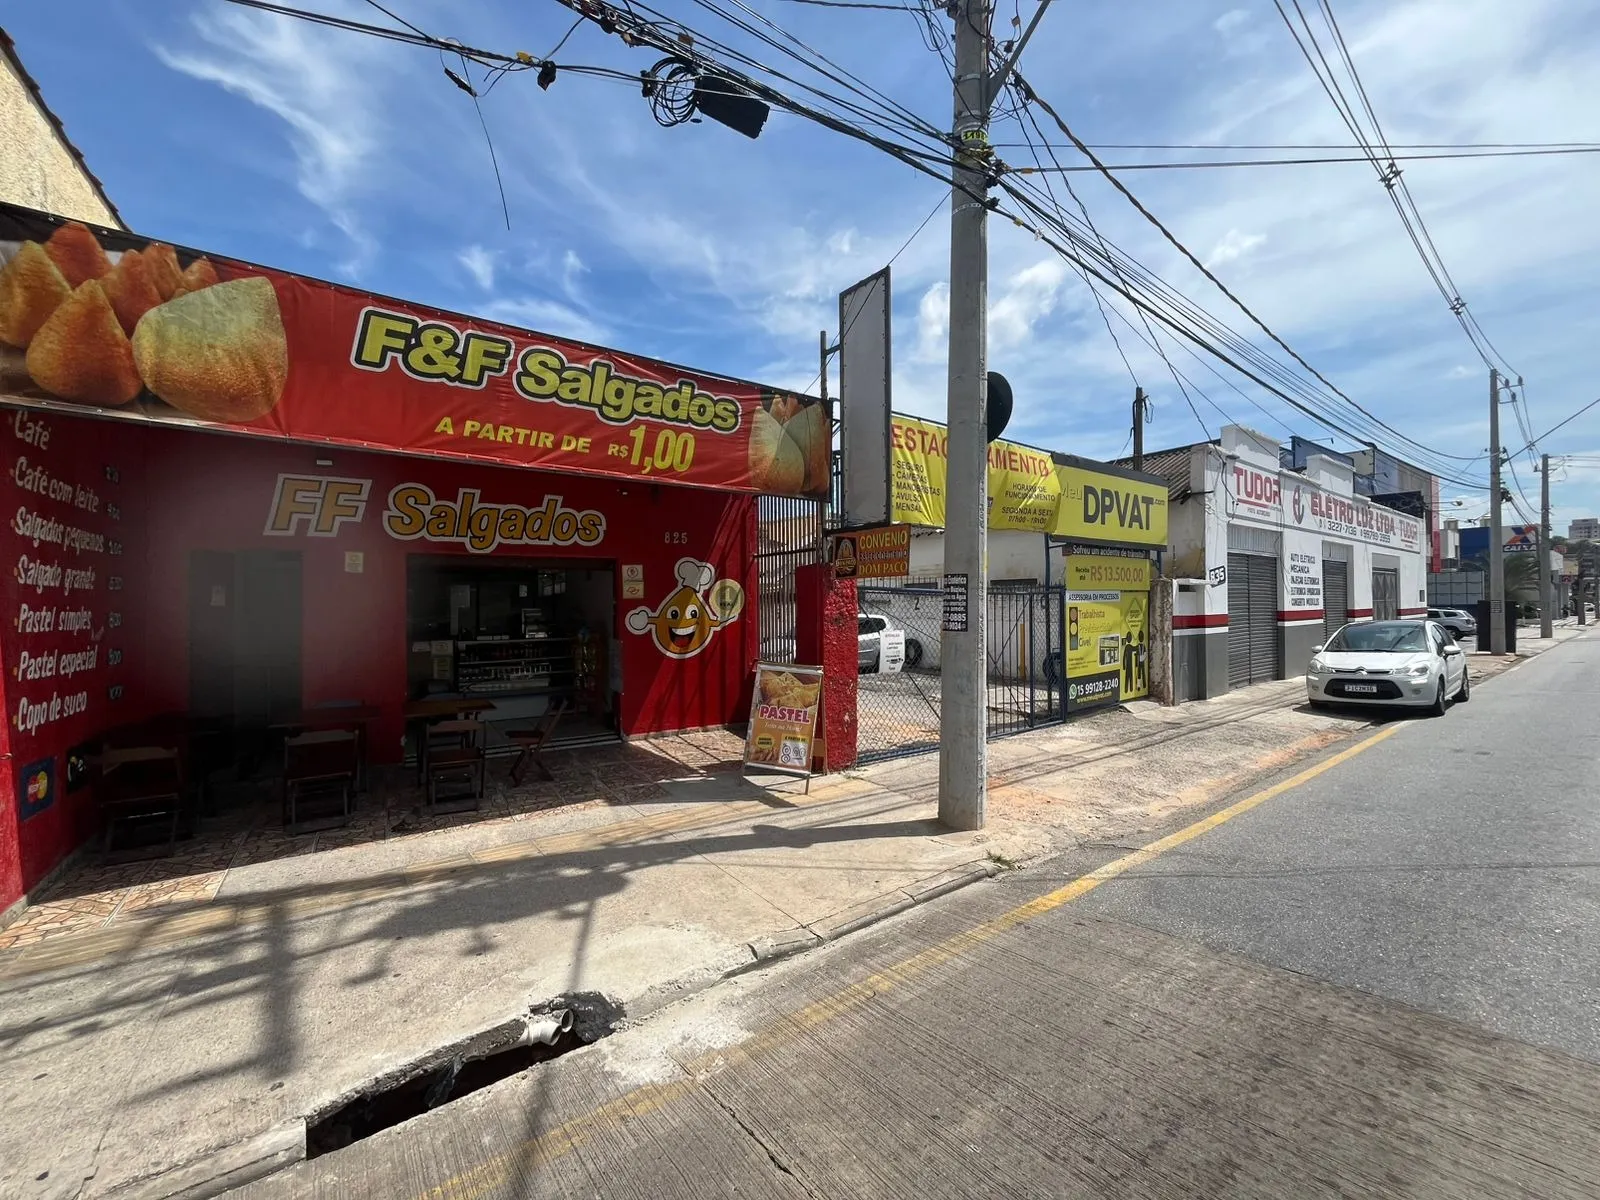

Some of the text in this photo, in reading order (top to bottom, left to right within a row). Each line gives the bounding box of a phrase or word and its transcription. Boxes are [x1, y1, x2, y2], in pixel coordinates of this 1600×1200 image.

[354, 308, 740, 432] F&F Salgados
[15, 410, 51, 450] Café
[435, 416, 455, 436] A
[463, 420, 554, 449] PARTIR
[561, 436, 592, 454] DE
[15, 456, 49, 495] Café
[49, 479, 73, 504] com
[75, 484, 100, 512] leite
[1233, 466, 1281, 506] TUDOR
[265, 475, 605, 552] FF Salgados
[1083, 484, 1154, 531] DPVAT
[1356, 505, 1374, 529] LUZ
[1376, 511, 1396, 536] LTDA
[15, 506, 64, 548] Salgados
[64, 526, 104, 555] pequenos
[664, 532, 688, 544] 825
[1399, 520, 1418, 541] TUDOR
[17, 554, 96, 596] Salgado grande
[859, 562, 880, 576] DOM
[1090, 565, 1144, 584] R$ 13.500,00
[18, 603, 57, 633] Pastel
[58, 607, 92, 636] simples
[18, 645, 98, 682] Pastel especial
[1077, 678, 1118, 696] 15 99128-2240
[18, 696, 48, 736] Copo
[49, 691, 61, 721] de
[64, 690, 88, 718] suco
[760, 705, 811, 725] PASTEL
